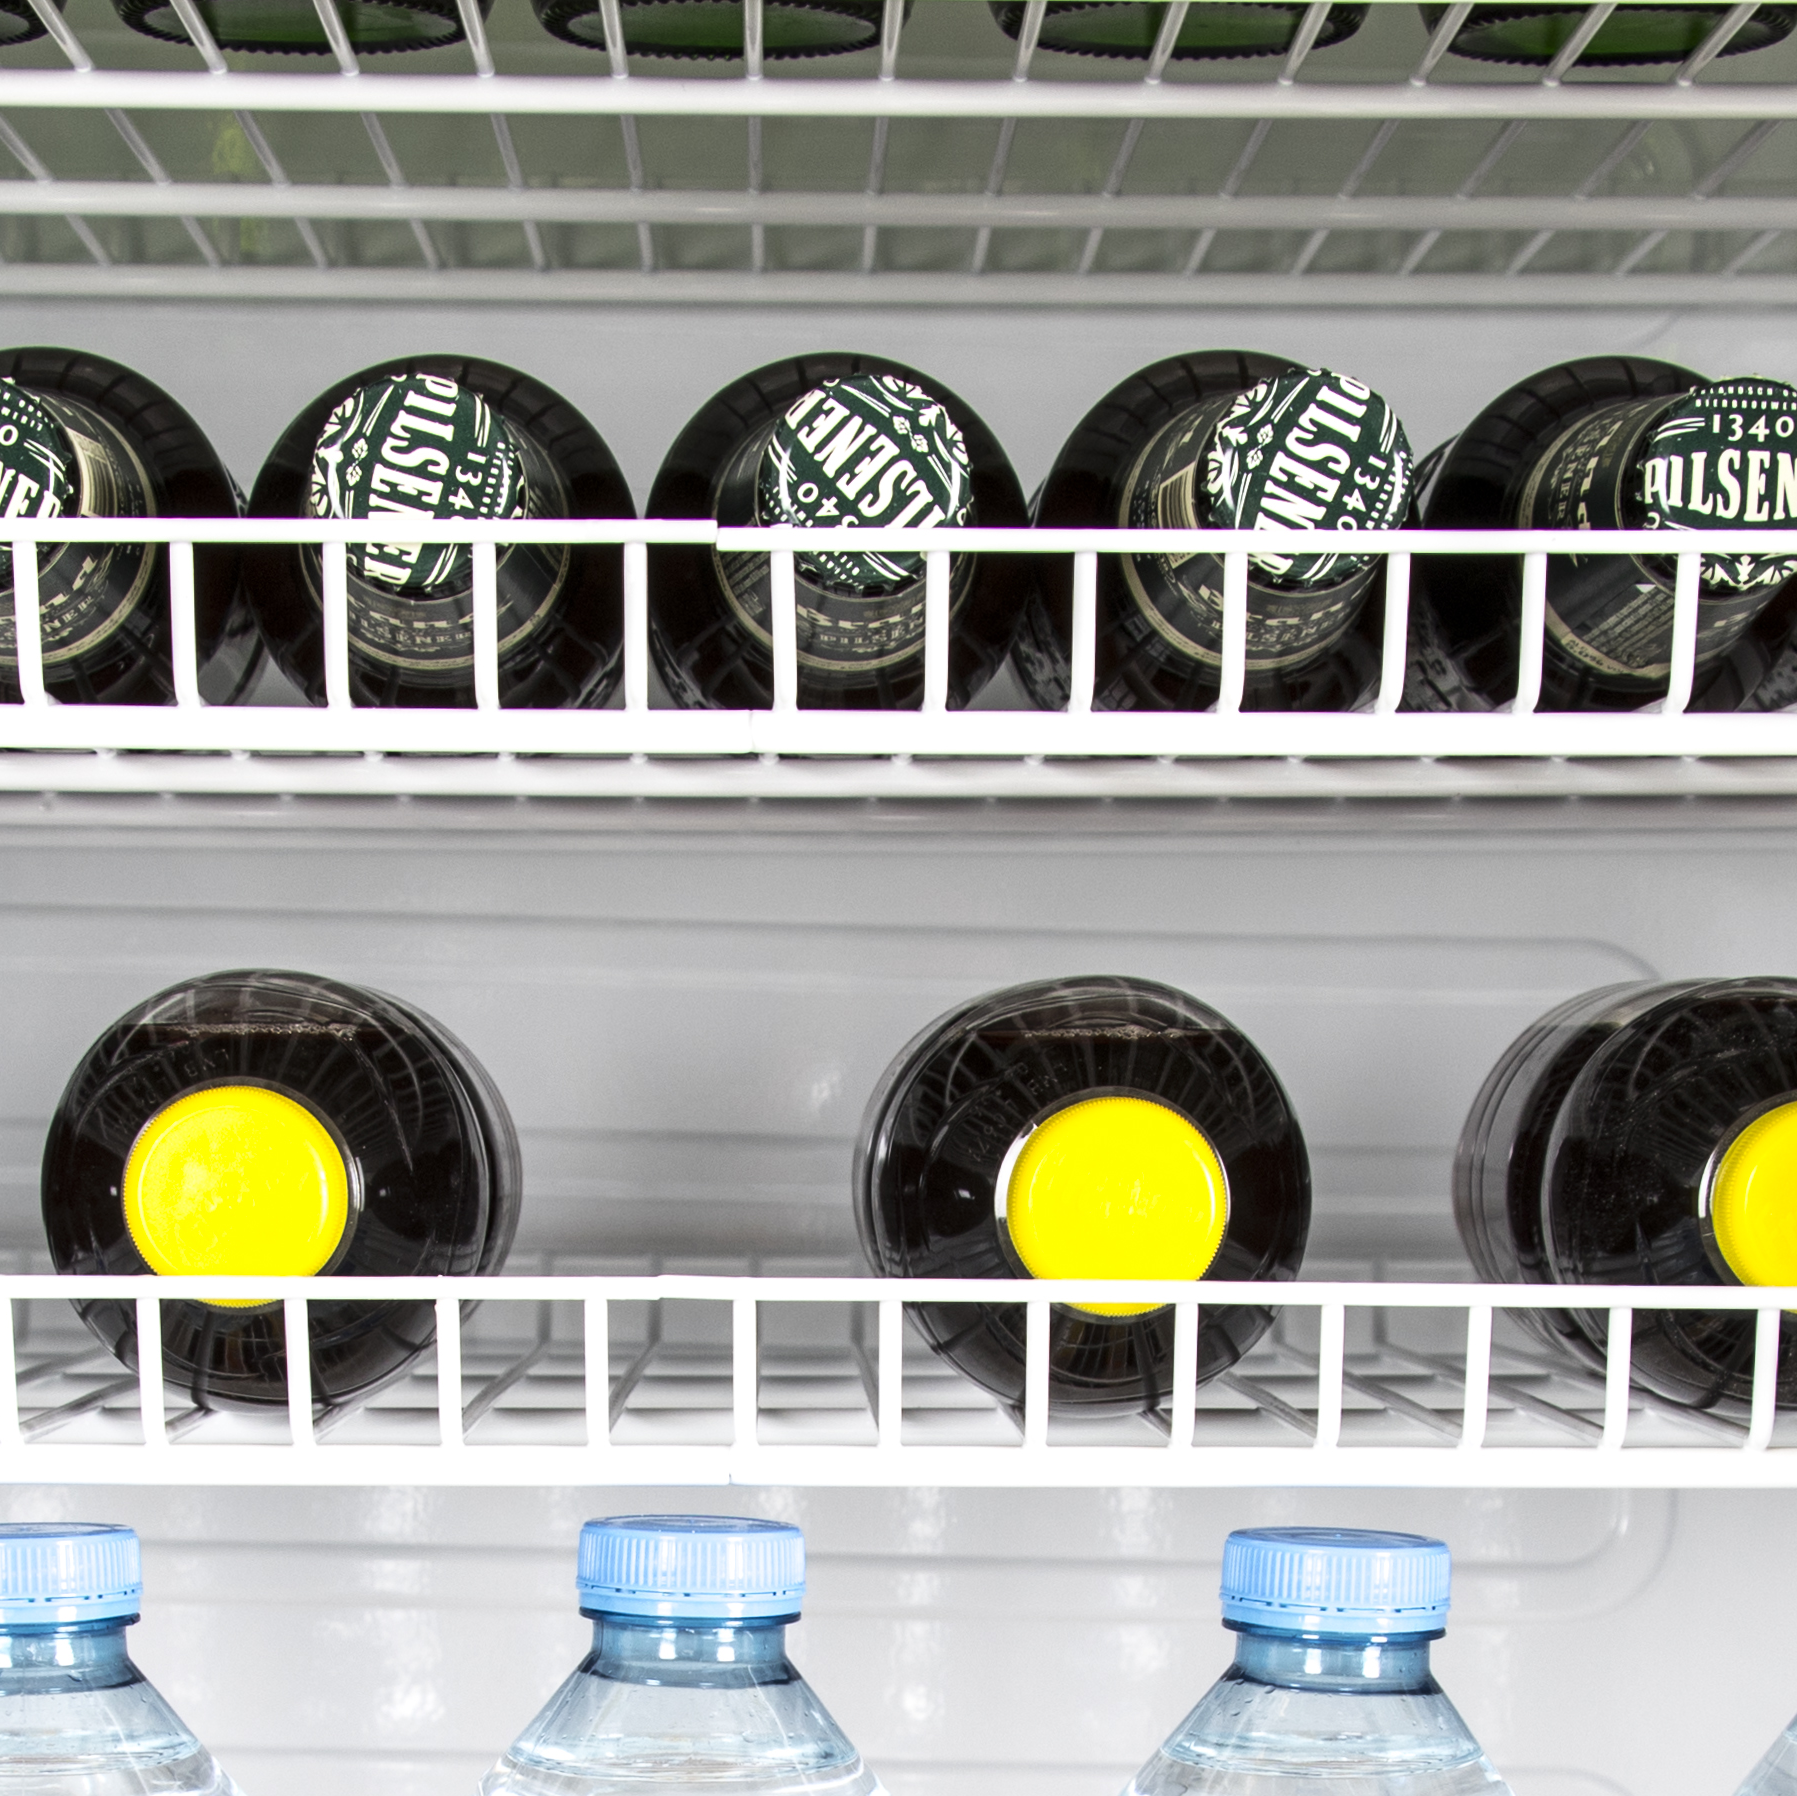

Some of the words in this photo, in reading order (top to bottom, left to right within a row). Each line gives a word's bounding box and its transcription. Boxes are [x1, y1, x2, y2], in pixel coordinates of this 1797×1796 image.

[784, 388, 947, 530] LSENER
[1712, 413, 1796, 443] 1340
[448, 451, 487, 519] 134
